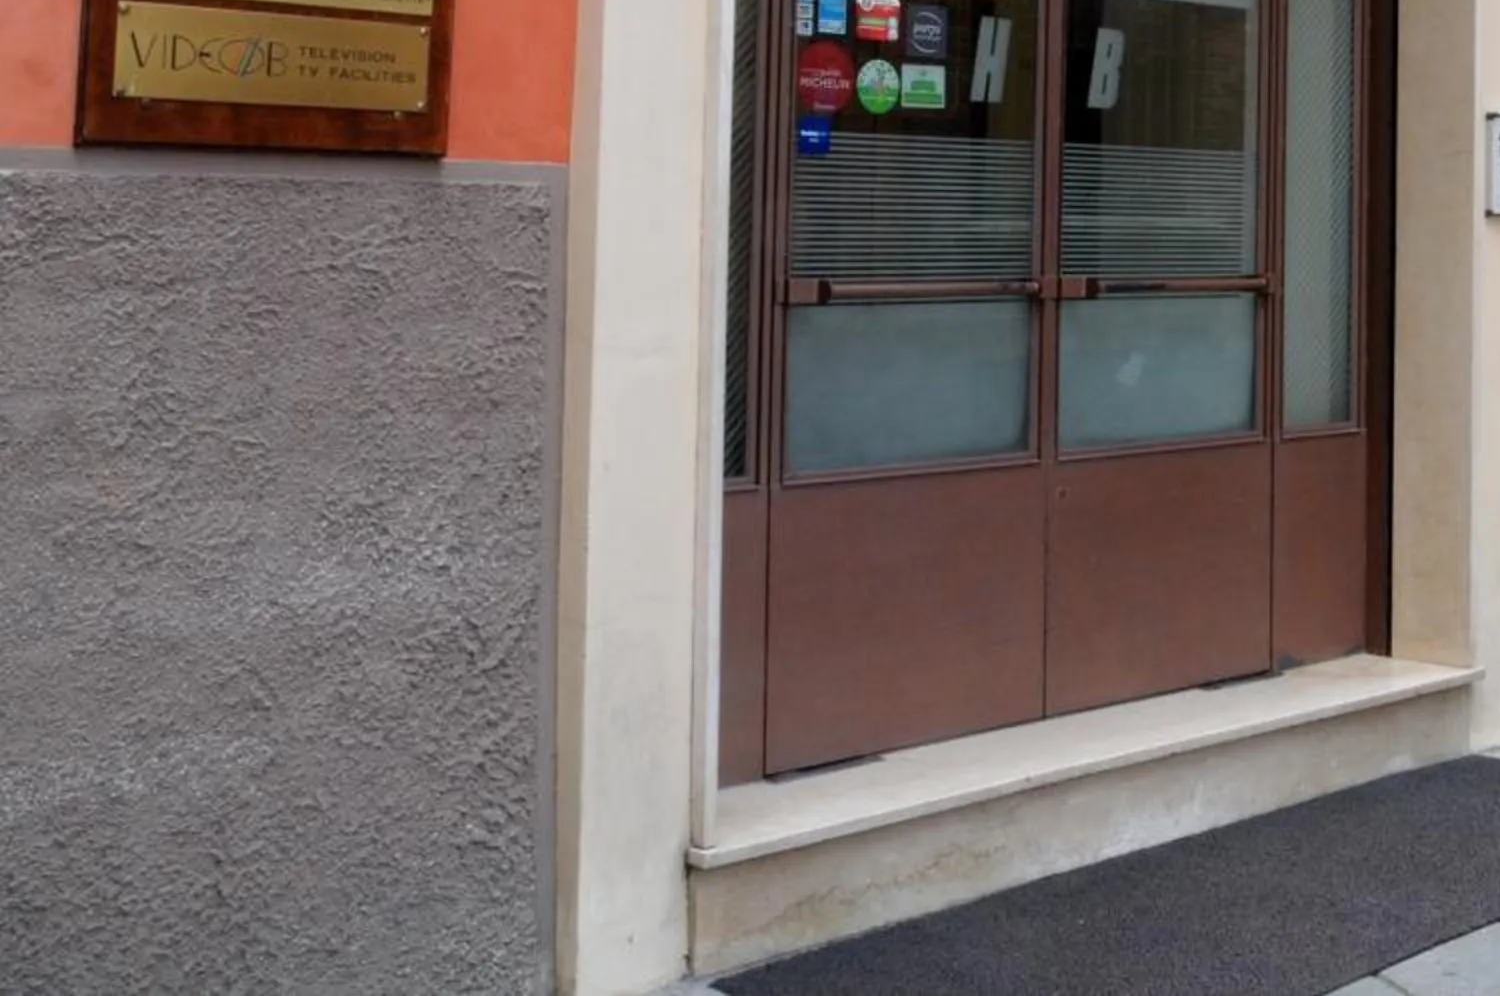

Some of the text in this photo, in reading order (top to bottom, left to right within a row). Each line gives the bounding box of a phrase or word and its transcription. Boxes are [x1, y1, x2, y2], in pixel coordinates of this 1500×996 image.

[298, 45, 396, 65] TELEVISION
[969, 15, 1126, 109] H B
[298, 64, 417, 84] TV FACILITIES
